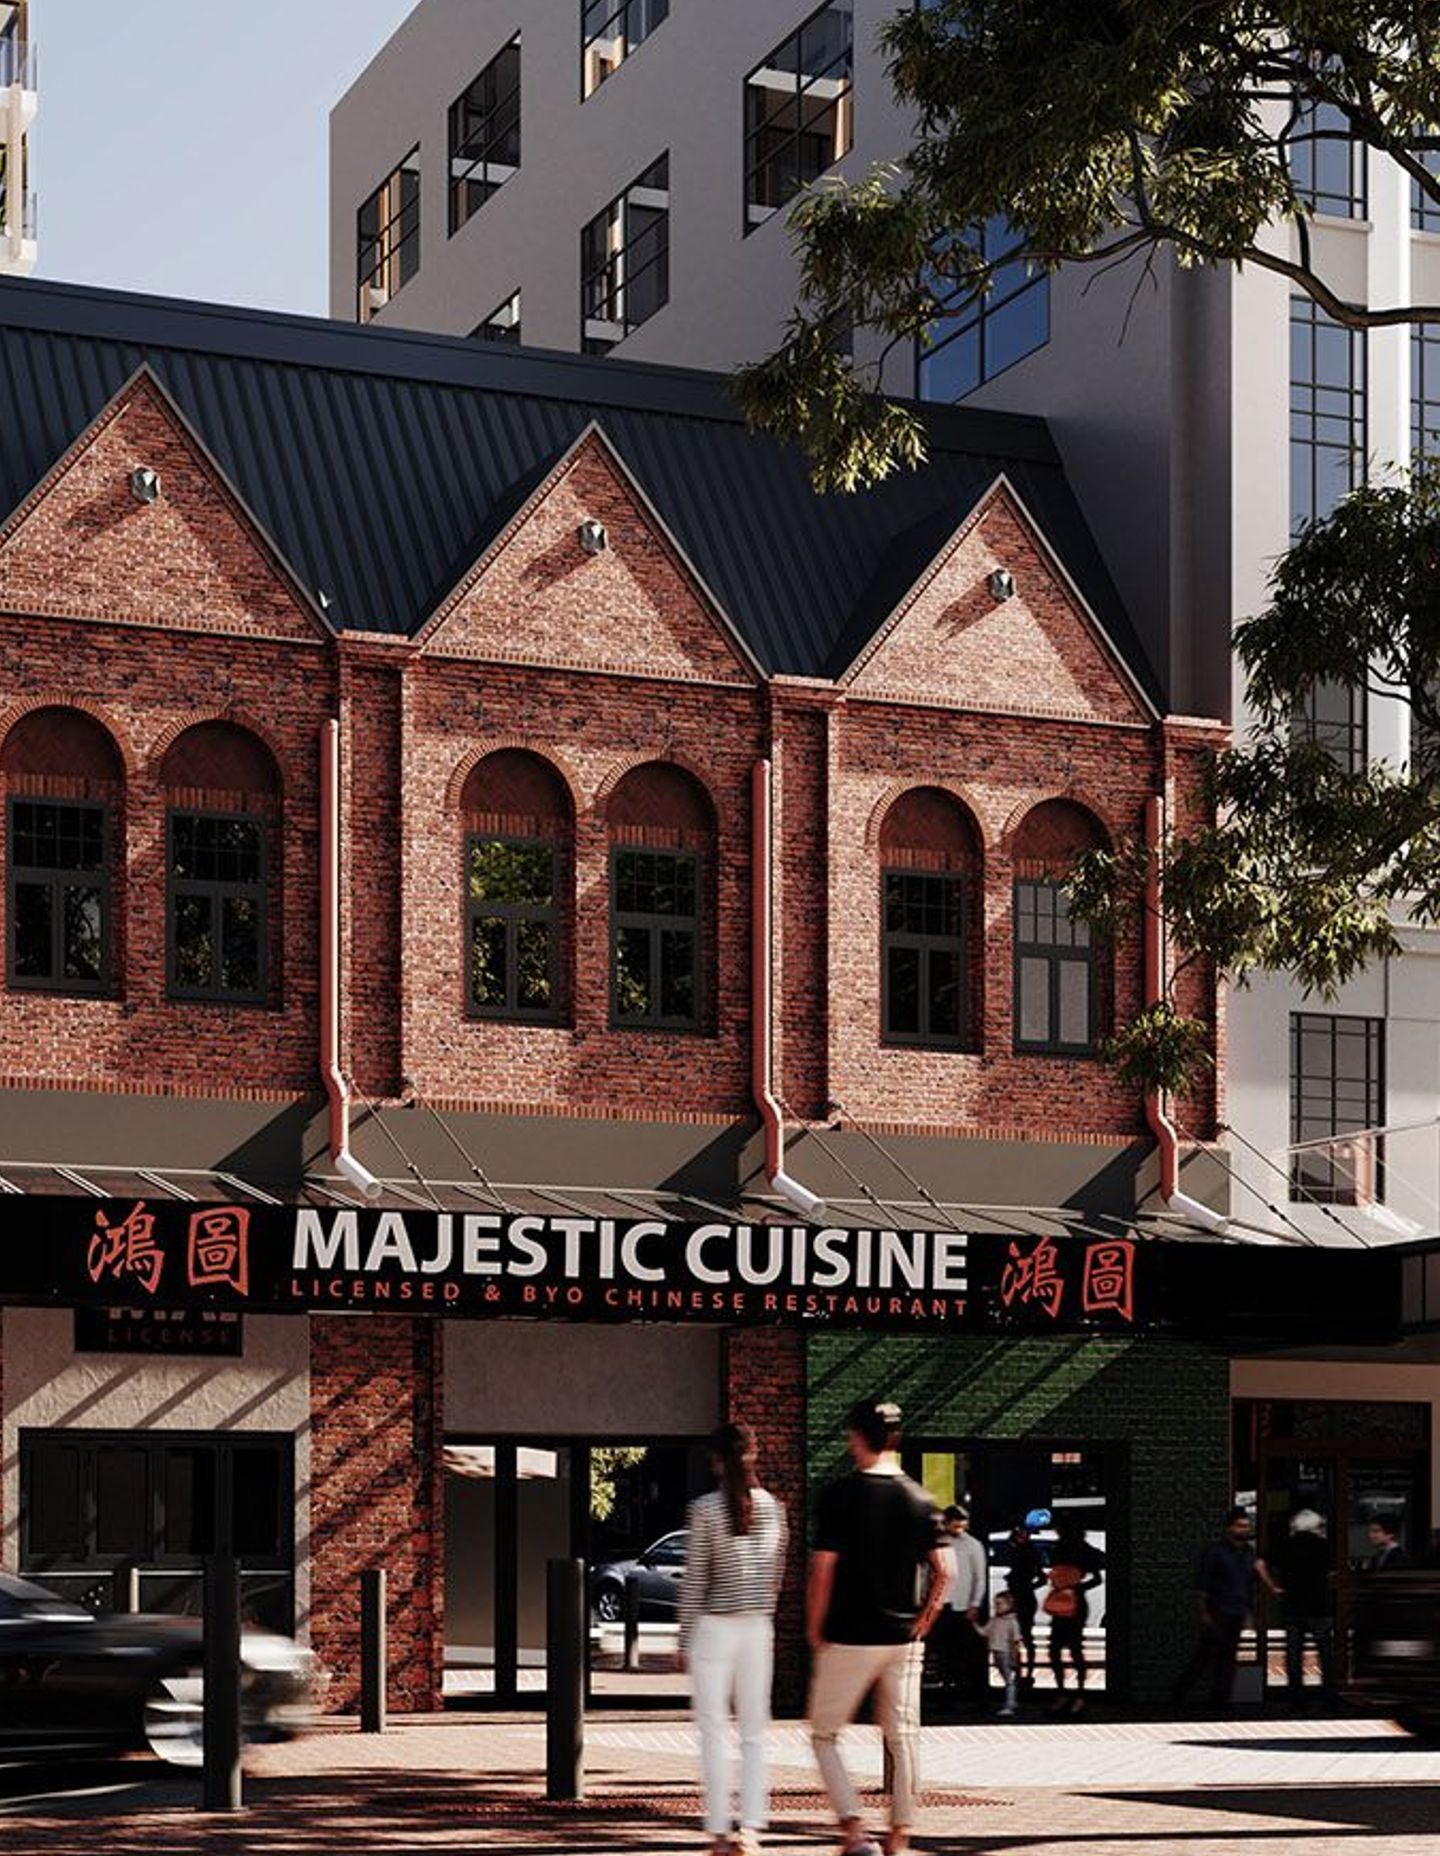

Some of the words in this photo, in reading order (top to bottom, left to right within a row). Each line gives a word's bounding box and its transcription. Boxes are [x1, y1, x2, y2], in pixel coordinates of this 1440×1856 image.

[87, 1200, 251, 1297] 鴻圖
[292, 1208, 668, 1282] MAJESTIC
[685, 1223, 969, 1291] CUISINE
[1000, 1233, 1136, 1323] 鴻圖
[291, 1278, 460, 1300] LICENSED
[484, 1284, 502, 1302] &
[523, 1284, 584, 1304] BYO
[605, 1288, 746, 1310] CHINESE
[763, 1293, 968, 1316] RESTAURANT
